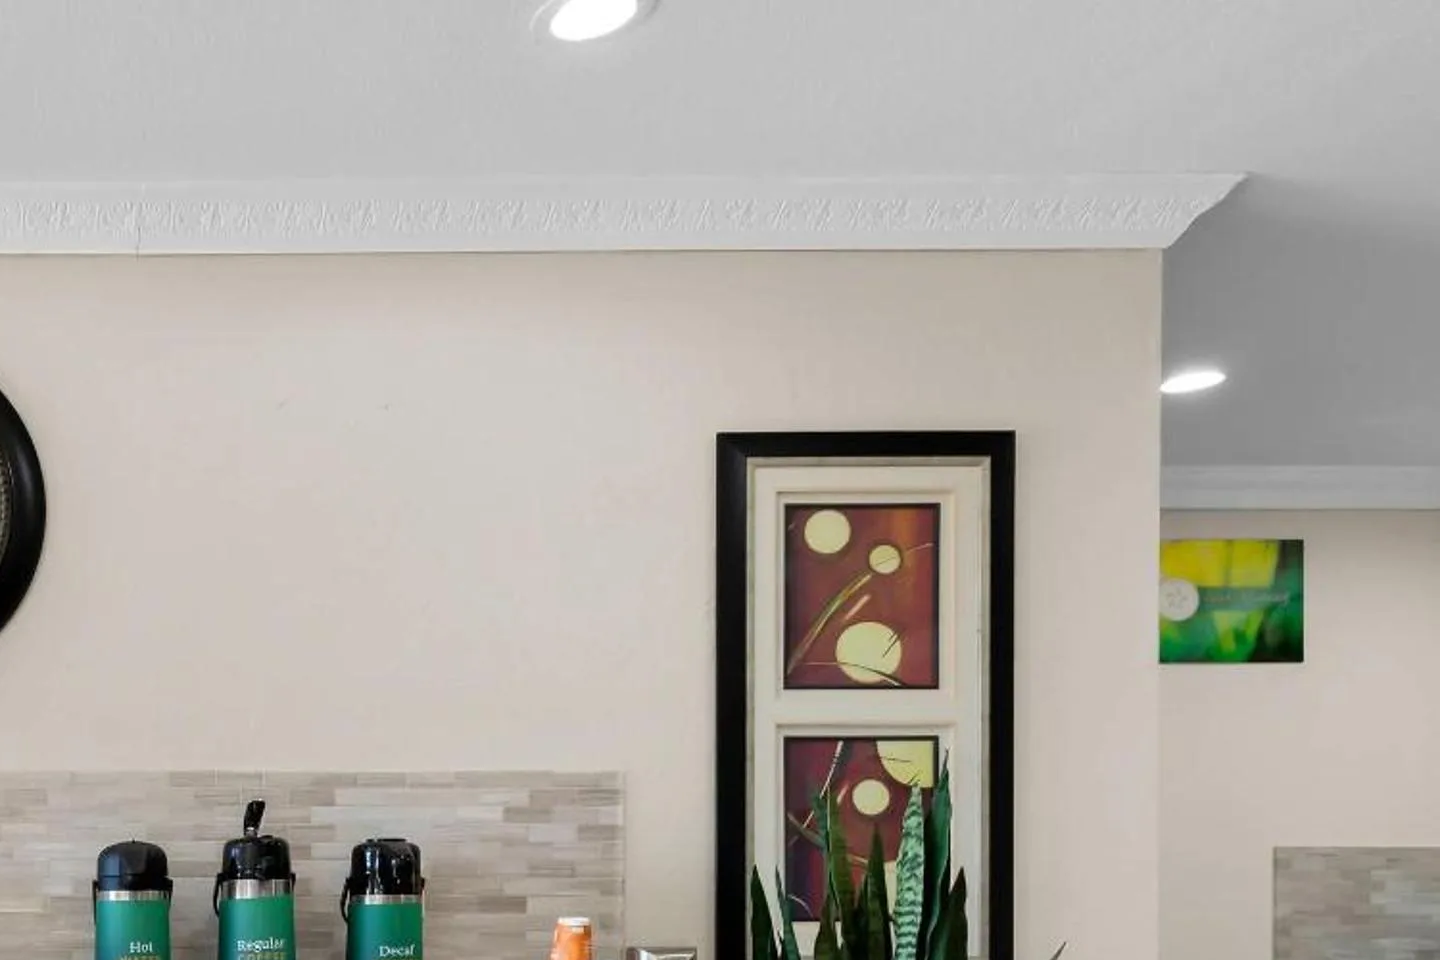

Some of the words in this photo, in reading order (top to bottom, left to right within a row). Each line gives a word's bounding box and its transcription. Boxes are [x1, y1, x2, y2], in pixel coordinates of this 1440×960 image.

[130, 941, 153, 953] Hot
[237, 937, 286, 953] Regular
[379, 944, 415, 957] Decaf
